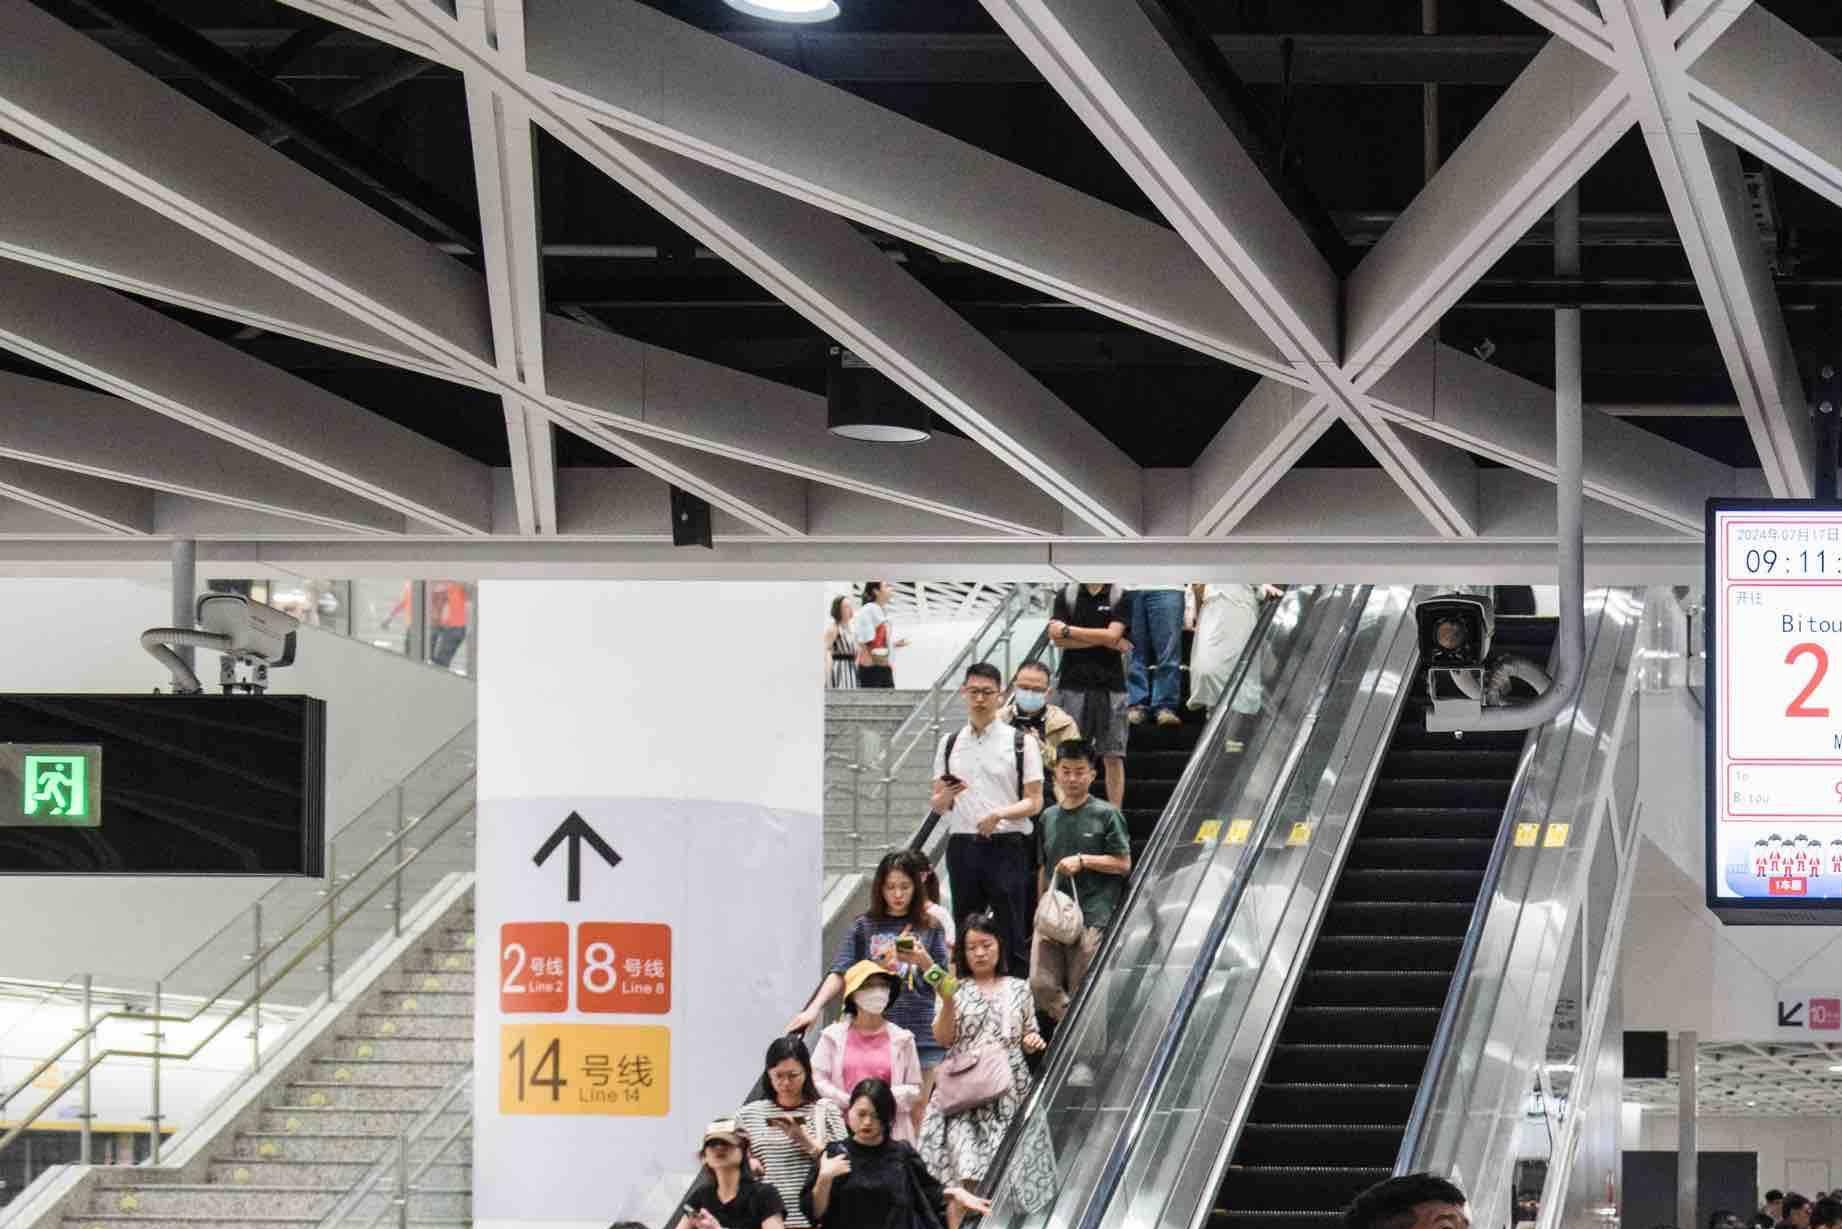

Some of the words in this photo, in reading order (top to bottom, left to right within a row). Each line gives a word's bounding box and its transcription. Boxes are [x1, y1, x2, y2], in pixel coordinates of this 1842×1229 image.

[1781, 613, 1842, 633] Bitou
[1784, 642, 1830, 718] 2
[1733, 791, 1771, 805] Bitou
[502, 942, 564, 994] 2号线
[582, 942, 666, 994] 8号线
[528, 981, 553, 993] Line
[554, 981, 564, 993] 2
[621, 981, 652, 995] Line
[656, 982, 665, 995] 8
[507, 1037, 654, 1102] 14号线
[578, 1087, 620, 1103] Line
[624, 1087, 640, 1103] 14
